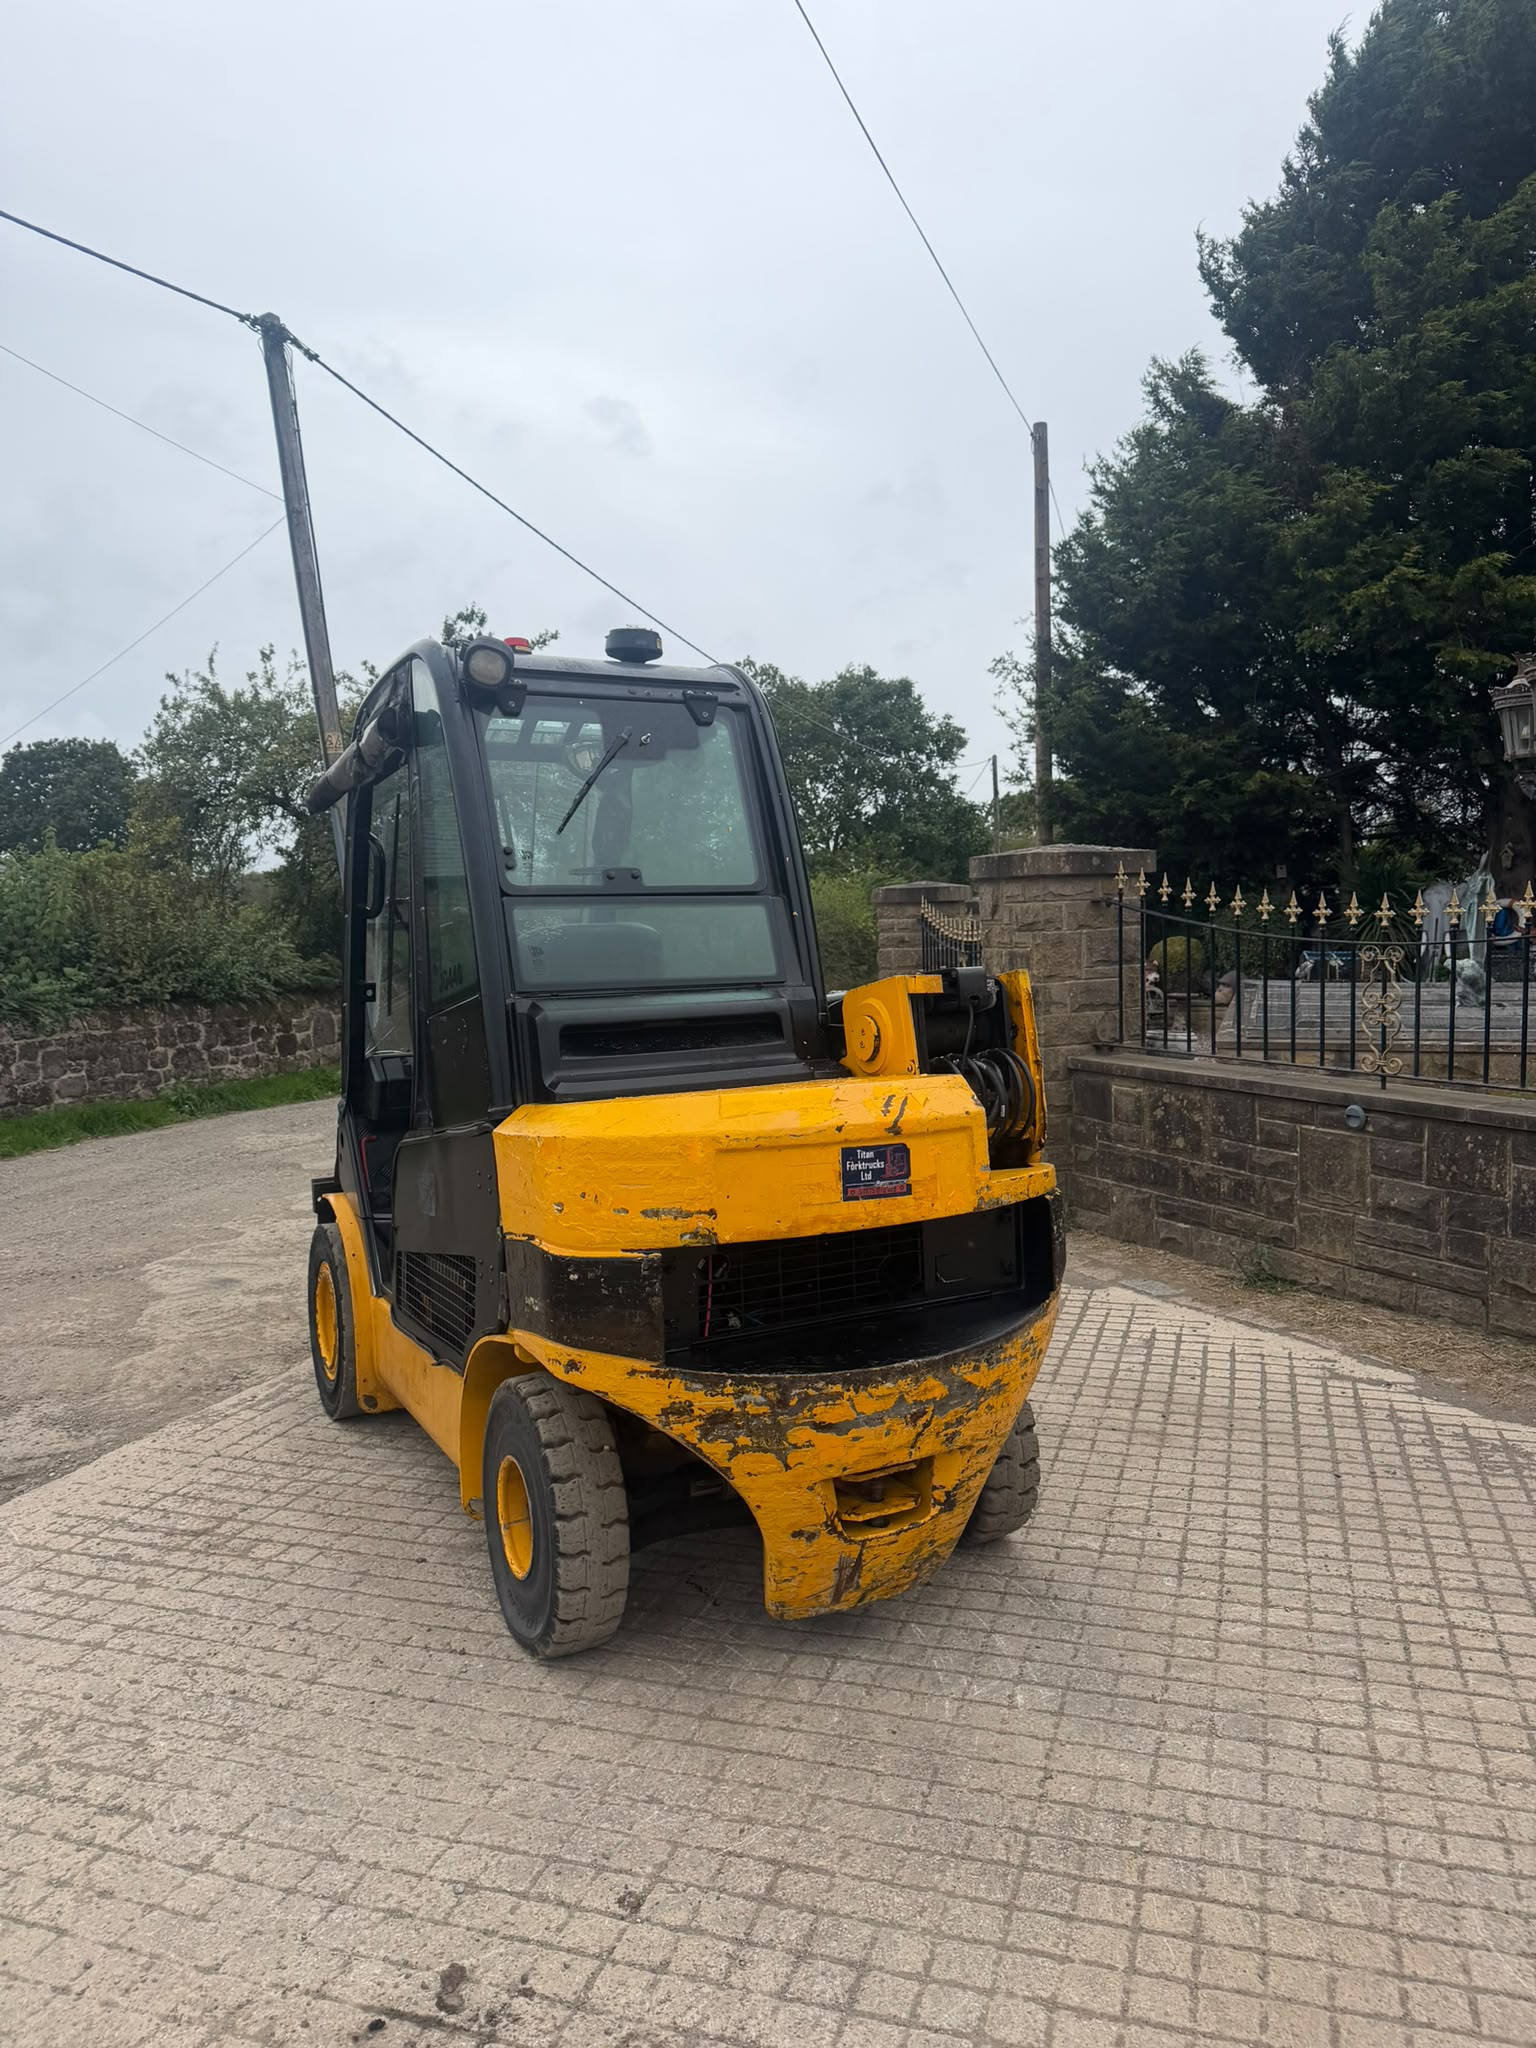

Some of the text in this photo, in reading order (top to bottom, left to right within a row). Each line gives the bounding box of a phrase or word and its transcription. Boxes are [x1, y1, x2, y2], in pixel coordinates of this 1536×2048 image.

[857, 1150, 874, 1159] Titan
[846, 1160, 885, 1171] Forktrucks
[861, 1171, 872, 1180] Ltd
